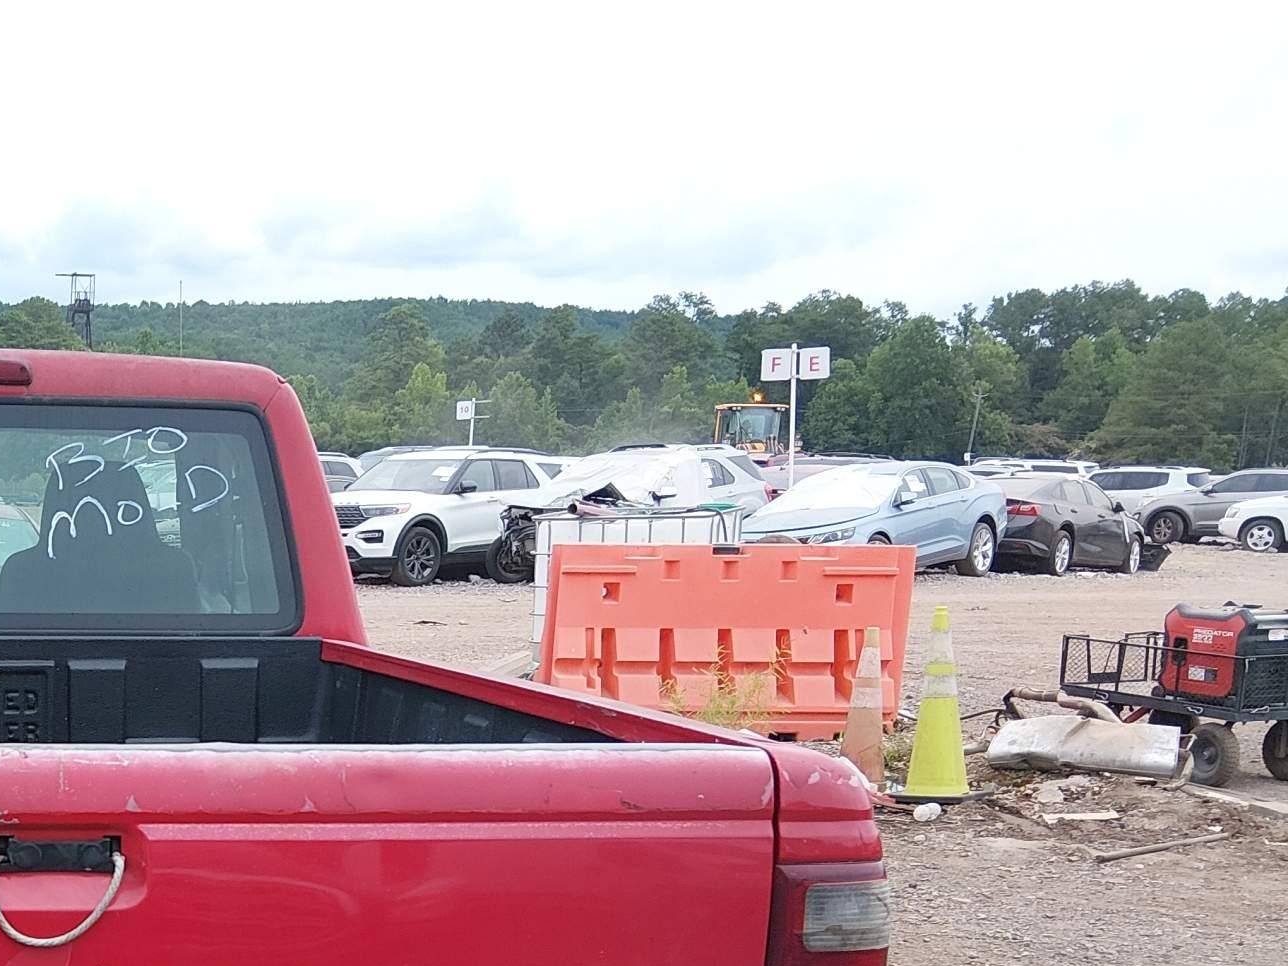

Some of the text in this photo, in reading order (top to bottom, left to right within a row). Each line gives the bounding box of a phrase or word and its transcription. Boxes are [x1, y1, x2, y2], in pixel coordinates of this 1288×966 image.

[771, 356, 783, 373] F
[809, 356, 820, 372] E
[460, 406, 470, 414] 10
